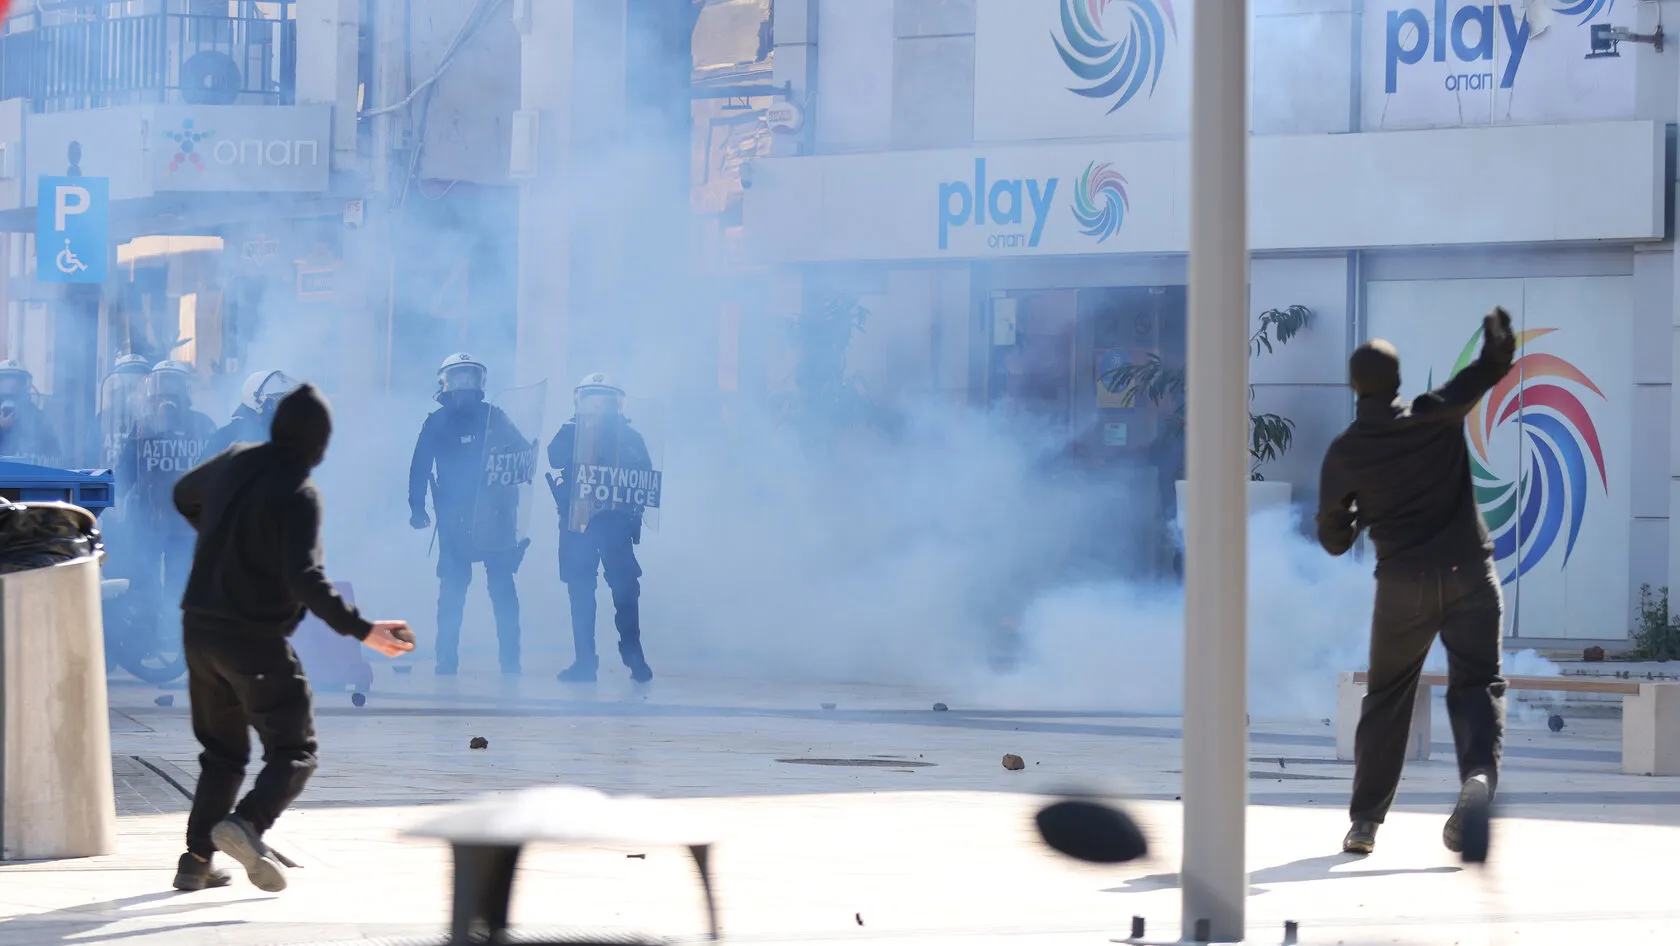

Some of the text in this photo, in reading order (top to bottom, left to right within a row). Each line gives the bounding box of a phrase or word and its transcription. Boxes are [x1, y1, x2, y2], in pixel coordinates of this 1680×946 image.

[1385, 0, 1530, 94] play
[55, 185, 91, 231] P
[938, 158, 1058, 249] play
[143, 439, 209, 458] ΑΣΤΥΝΟΜ
[485, 447, 533, 473] ΑΣΤΥΝΟ
[576, 464, 659, 491] ΑΣΤΥΝΟΜΙΑ
[579, 485, 656, 507] POLICE
